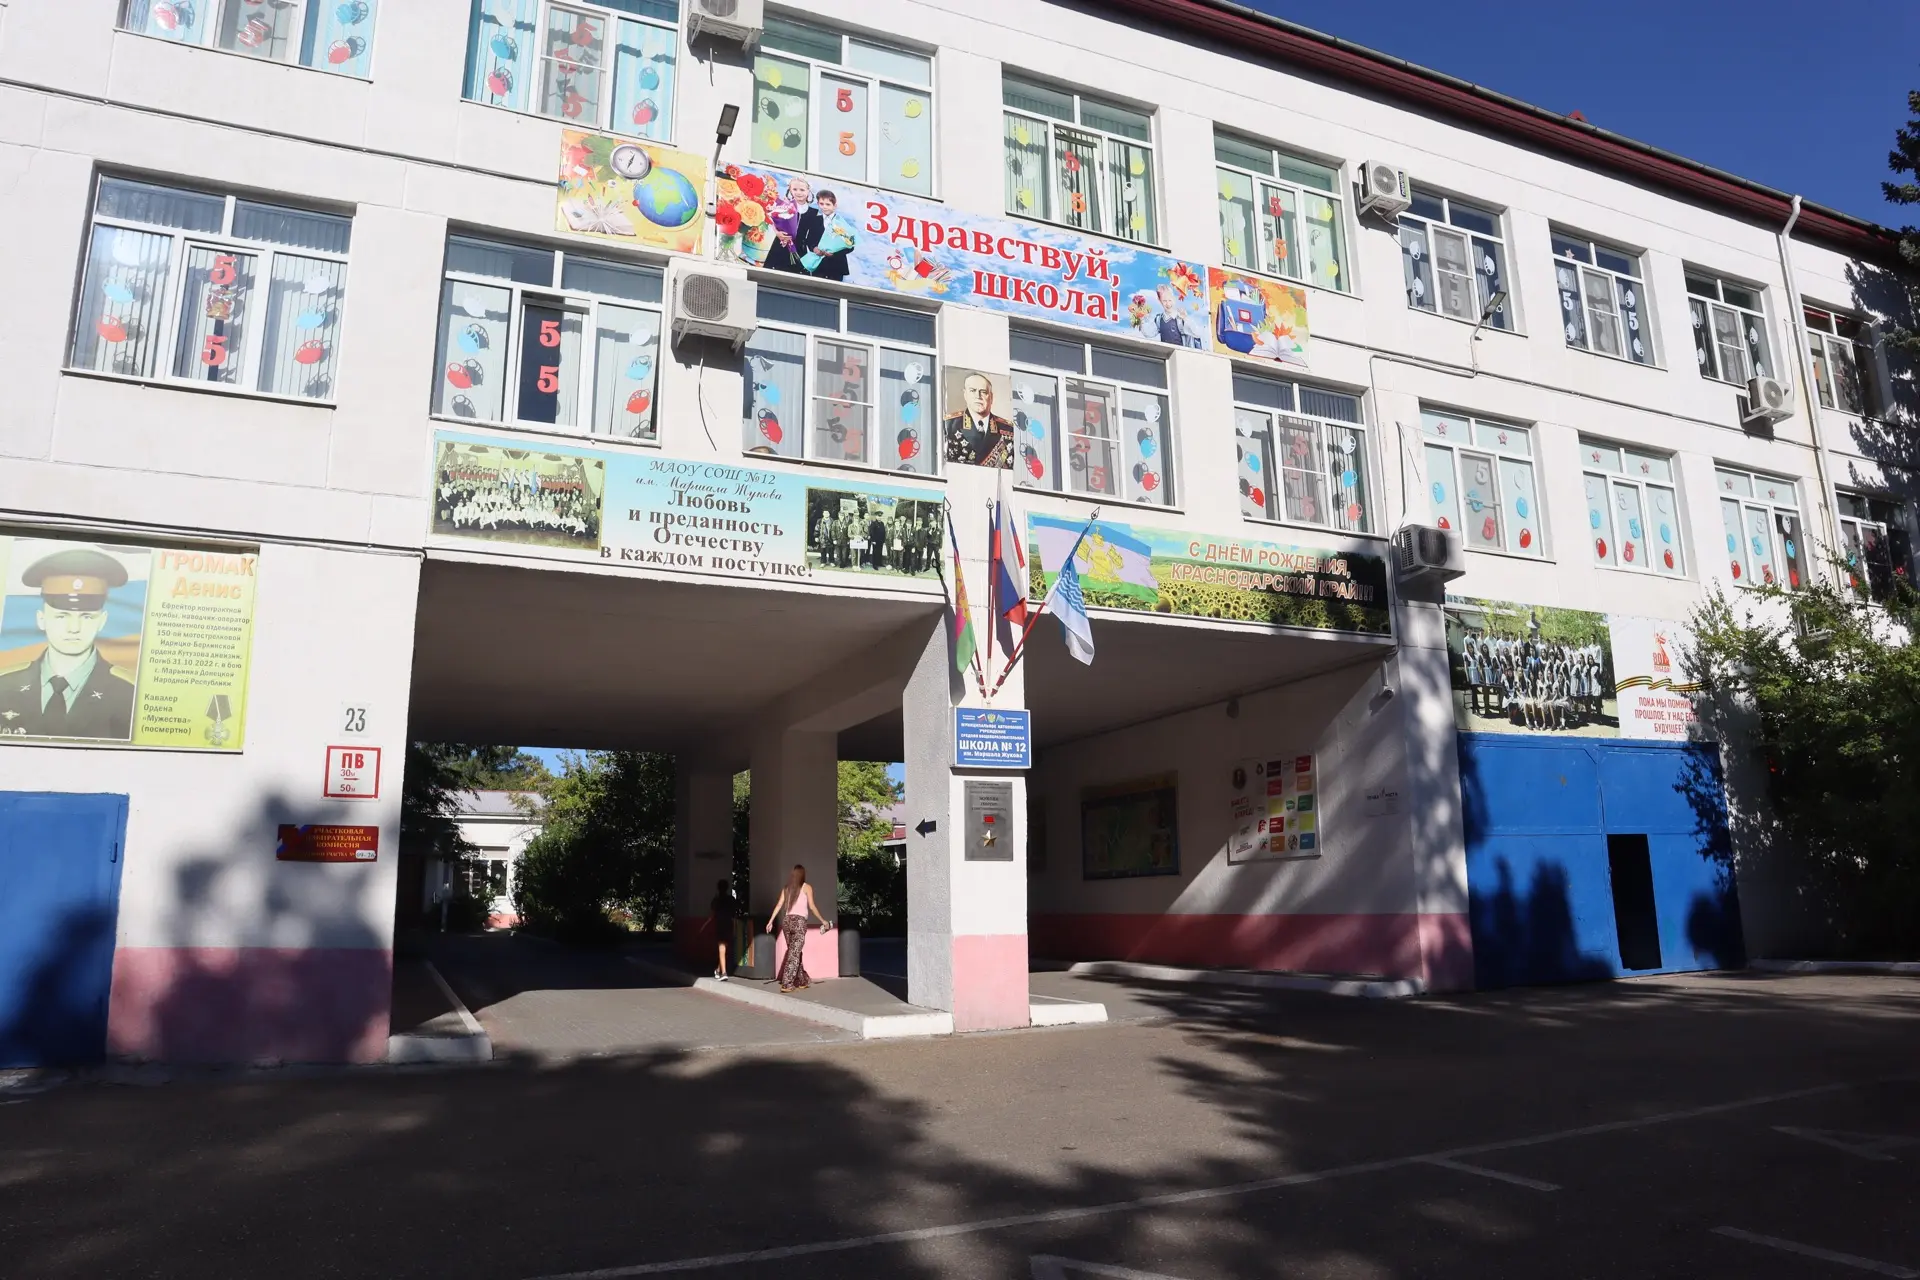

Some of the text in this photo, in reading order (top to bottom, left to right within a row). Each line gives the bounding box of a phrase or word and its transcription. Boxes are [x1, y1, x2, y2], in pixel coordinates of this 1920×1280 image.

[837, 88, 853, 112] 5
[839, 132, 856, 156] 5
[1064, 151, 1080, 171] 5
[1071, 192, 1086, 213] 5
[1270, 196, 1283, 217] 5
[866, 202, 1120, 287] Здравствуй,
[1274, 237, 1287, 259] 5
[211, 255, 236, 284] 5
[973, 270, 1119, 321] школа!
[1562, 291, 1574, 310] 5
[1628, 311, 1639, 330] 5
[539, 320, 561, 347] 5
[201, 335, 228, 366] 5
[537, 365, 559, 393] 5
[649, 461, 776, 485] МАОУ СОШ №12
[636, 476, 782, 501] им. Маршала Жукова
[668, 490, 751, 514] Любовь
[628, 509, 784, 536] и преданность
[653, 527, 764, 557] Отечеству
[1624, 540, 1635, 562] 5
[158, 551, 255, 576] ГРОМАК
[600, 546, 813, 578] в каждом поступке!
[1189, 542, 1351, 579] С ДНЁМ РОЖДЕНИЯ,
[171, 577, 241, 599] Денис
[1171, 563, 1373, 601] КРАСНОДАРСКИЙ КРАЙ!!!
[151, 611, 250, 624] службы, наводчик-оператор
[162, 602, 241, 614] Ефрейтор контрактной
[157, 621, 204, 630] минометного
[157, 629, 171, 637] 150
[183, 632, 241, 641] мотострелковой
[149, 656, 171, 665] Погиб
[172, 658, 213, 667] 31.10.2022
[151, 648, 242, 660] ордена Кутузова дивизии.
[153, 676, 232, 687] Народной Республики
[162, 667, 198, 676] Марьинка
[200, 669, 234, 677] Донецкой
[143, 703, 173, 712] Ордена
[144, 693, 178, 702] Кавалер
[1638, 696, 1655, 707] ПОКА
[1656, 698, 1667, 708] МЫ
[142, 715, 192, 724] «Мужества»
[345, 707, 366, 732] 23
[1635, 709, 1667, 720] ПРОШЛОЕ,
[1672, 711, 1684, 721] НАС
[141, 725, 192, 735] (посмертно)
[1654, 723, 1684, 734] БУДУЩЕЕ!
[959, 740, 1026, 752] ШКОЛА № 12
[341, 752, 364, 769] ПВ
[340, 769, 355, 777] 30м
[340, 784, 356, 792] 50м
